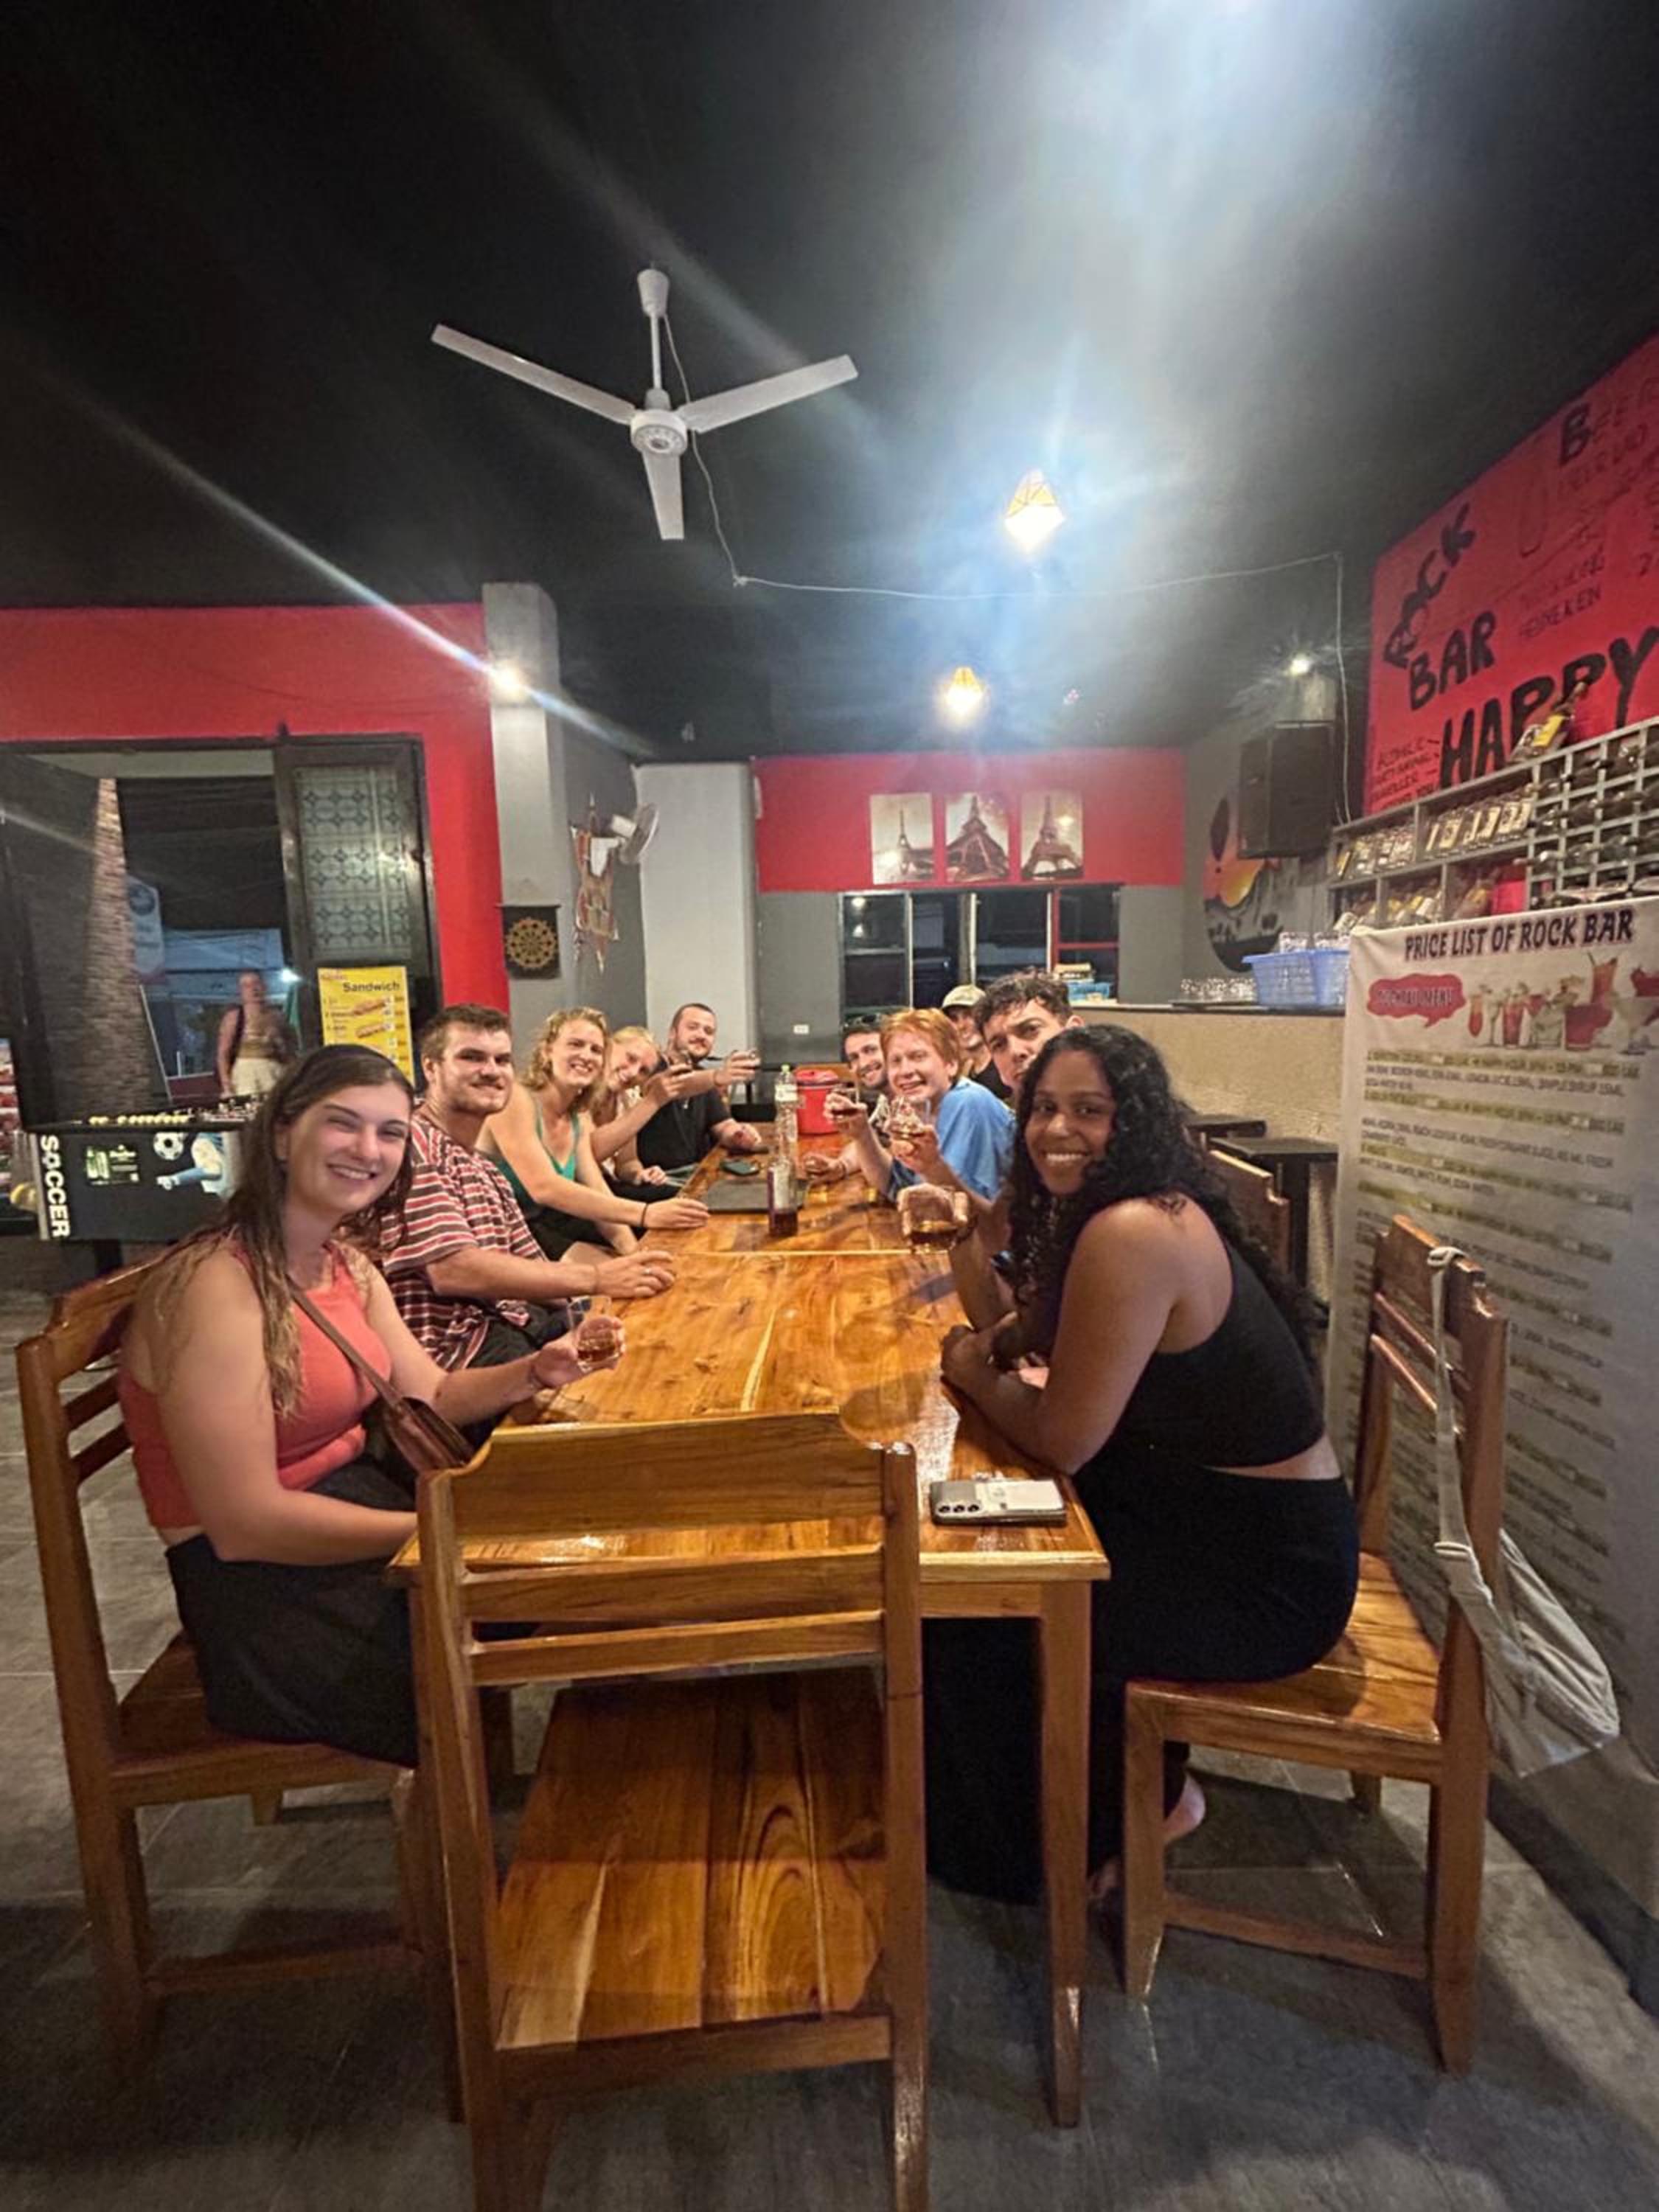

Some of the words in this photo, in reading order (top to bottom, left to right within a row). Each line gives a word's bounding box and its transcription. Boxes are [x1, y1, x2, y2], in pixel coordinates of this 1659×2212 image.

[1383, 501, 1475, 669] ROCK
[1410, 610, 1496, 710] BAR
[1439, 625, 1659, 790] HAPPY
[1405, 931, 1448, 961] PRICE
[1452, 928, 1488, 957] LIST
[1490, 922, 1515, 953] OF
[1517, 916, 1579, 951] ROCK
[1582, 907, 1635, 945] BAR
[342, 981, 400, 993] Sandwich
[40, 1135, 71, 1238] SOCCER
